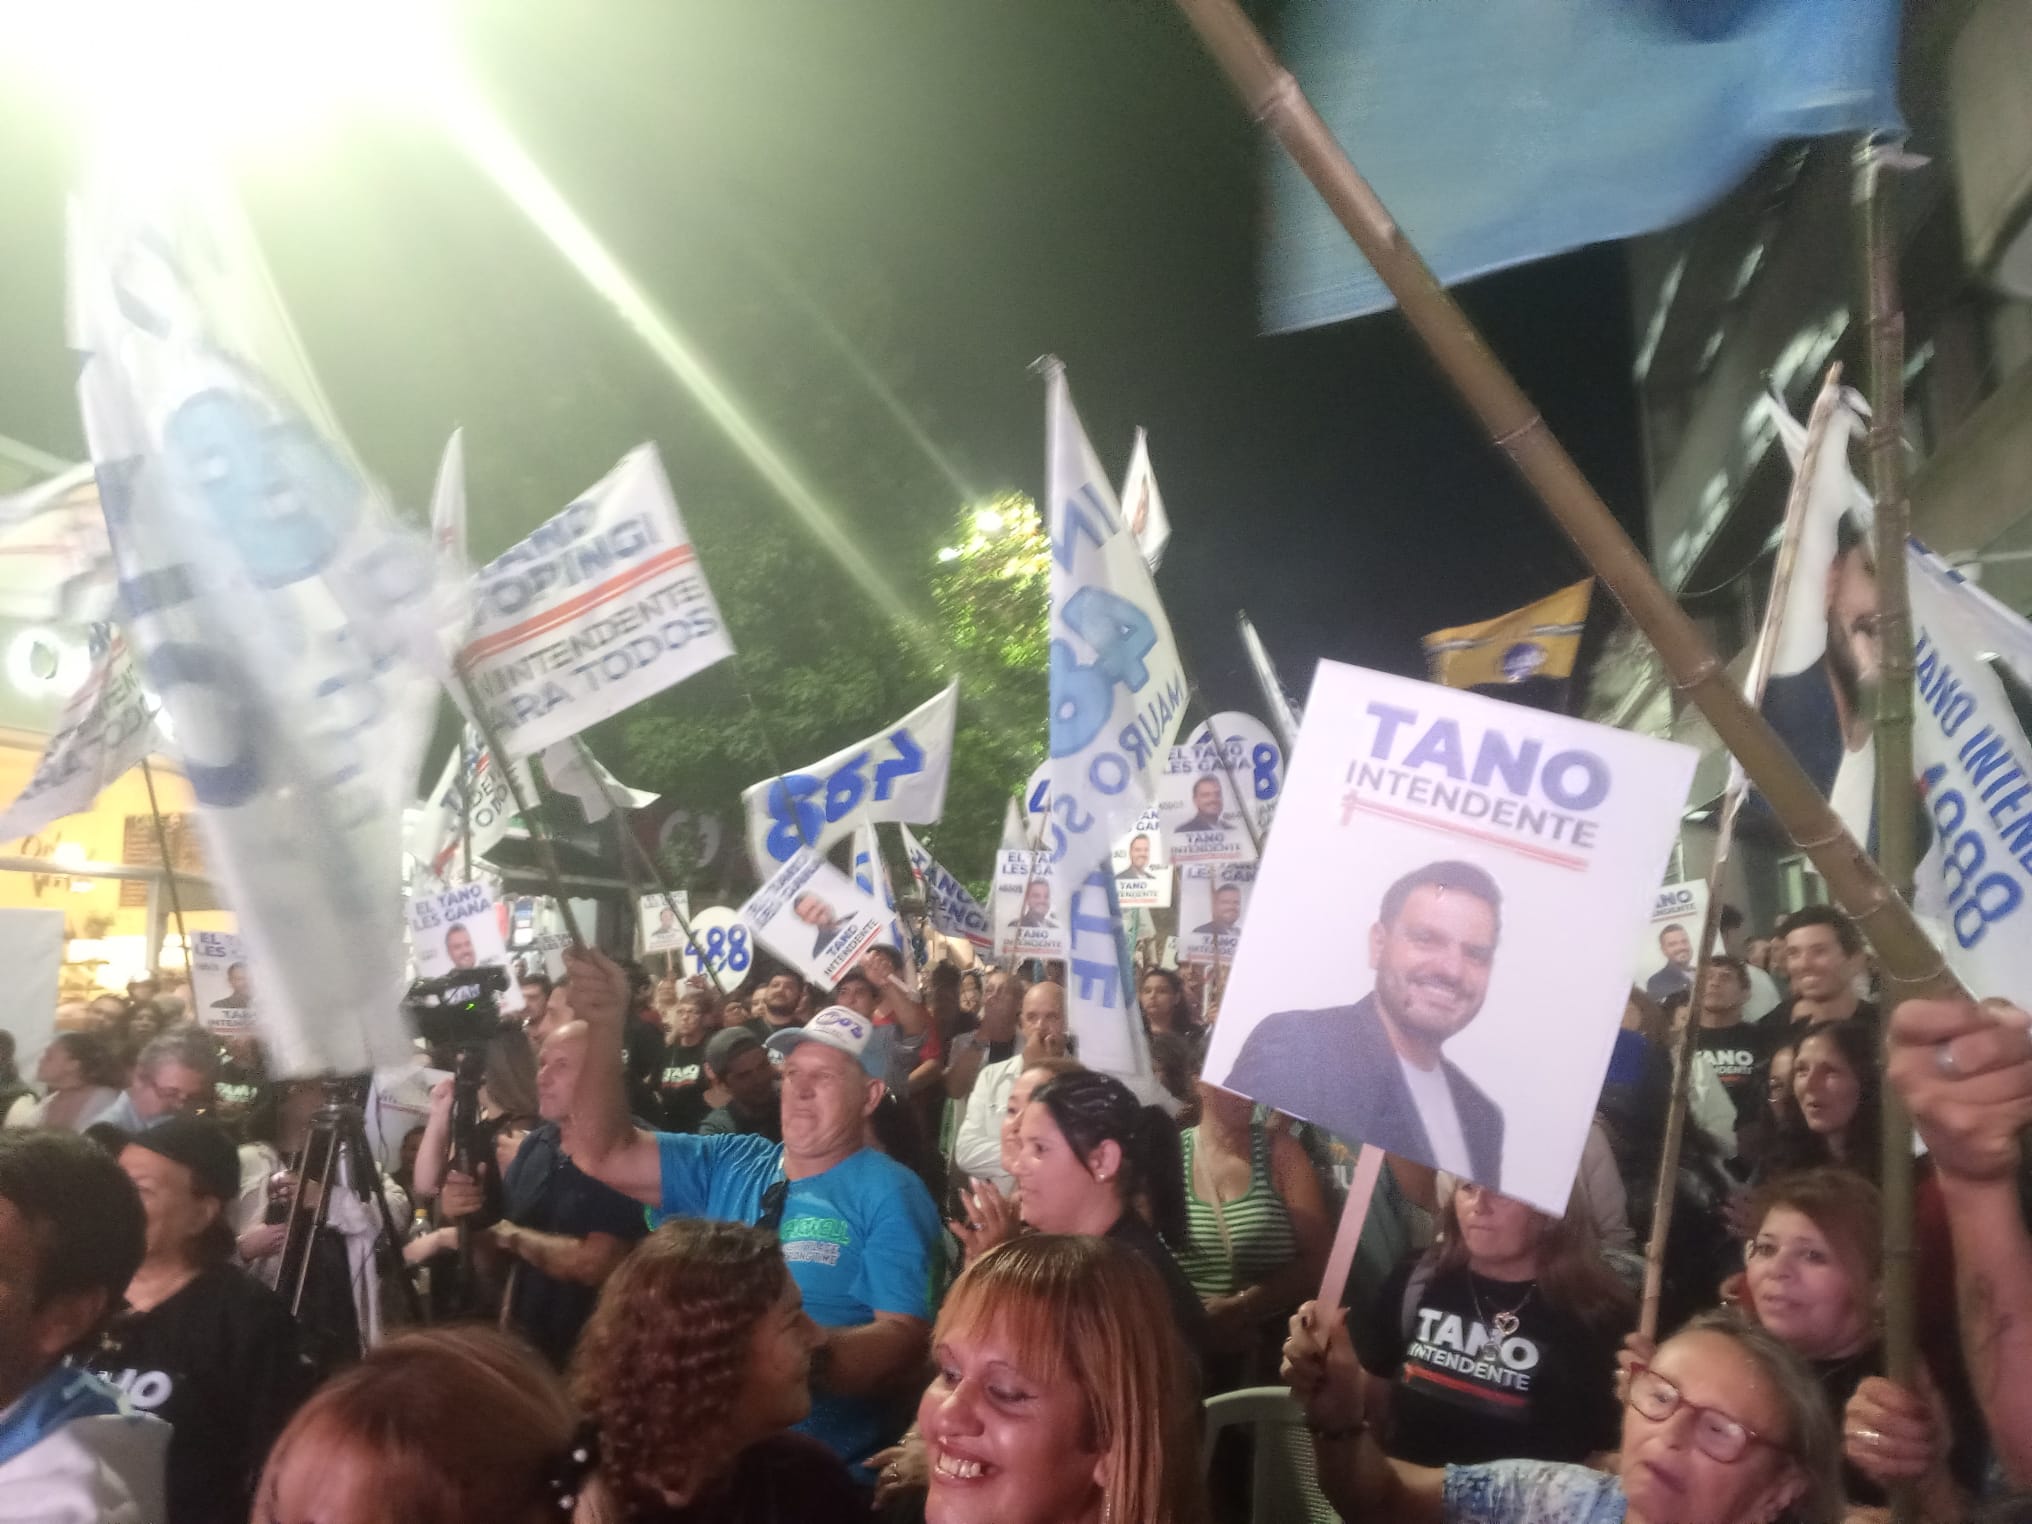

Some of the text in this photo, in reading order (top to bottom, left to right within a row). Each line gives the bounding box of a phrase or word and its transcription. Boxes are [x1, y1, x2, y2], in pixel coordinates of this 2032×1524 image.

[570, 604, 718, 692] TODOS
[1366, 701, 1612, 811] TANO
[1345, 758, 1600, 850] INTENDENTE
[412, 897, 492, 931] LES GANA
[415, 884, 482, 916] EL TANO
[684, 923, 750, 974] 488
[1407, 1342, 1532, 1391] INTENDENTE
[1417, 1307, 1540, 1371] TANO
